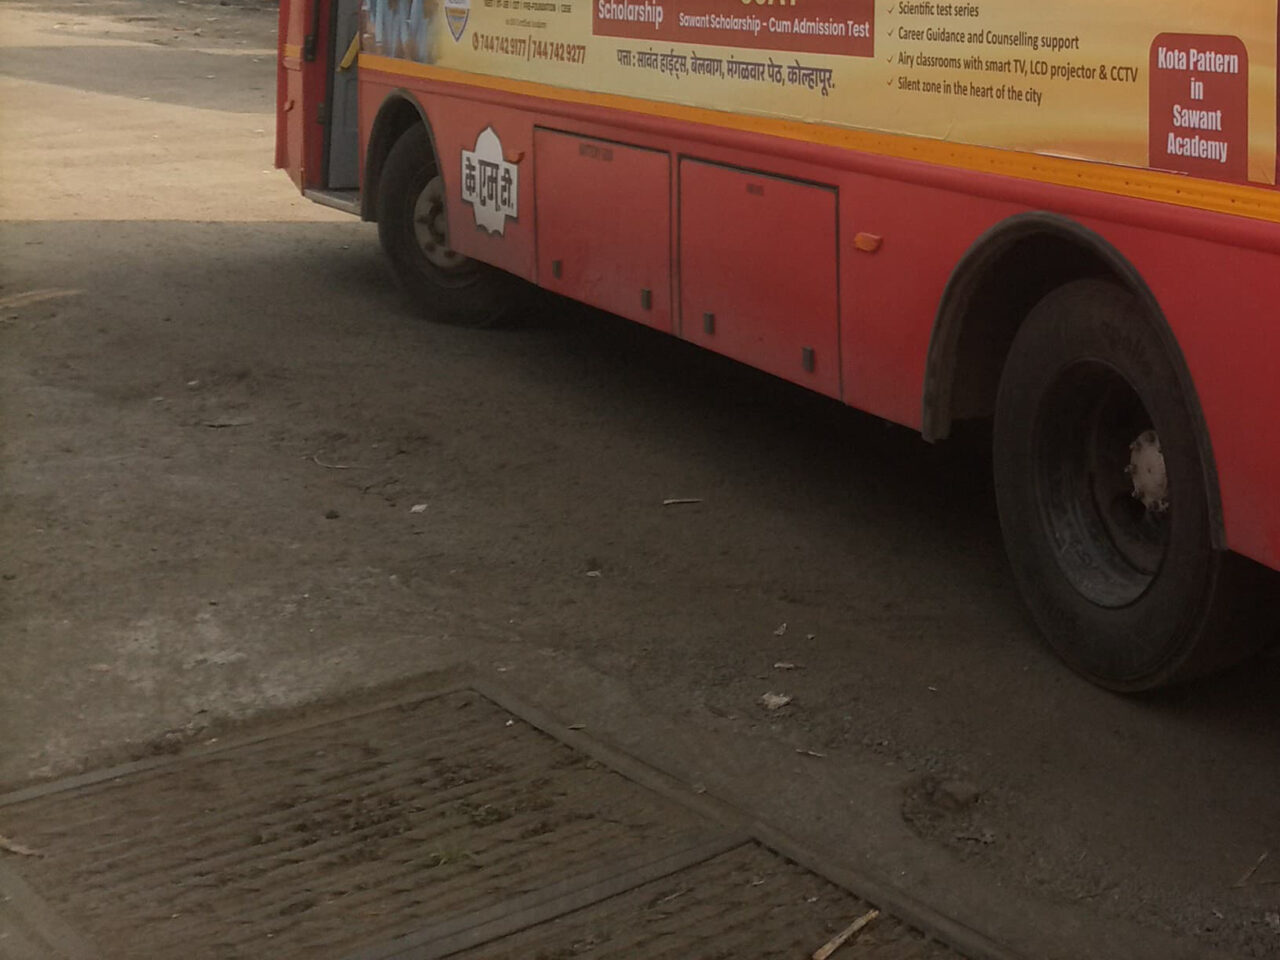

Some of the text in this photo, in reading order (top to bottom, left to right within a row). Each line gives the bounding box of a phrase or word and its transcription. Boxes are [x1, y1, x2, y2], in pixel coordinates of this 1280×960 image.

[598, 0, 664, 29] Scholarship
[898, 2, 979, 17] Scientific test series
[679, 12, 709, 28] Sawant
[710, 14, 761, 36] Scholarship
[768, 17, 792, 33] Cum
[793, 18, 845, 37] Admission
[847, 20, 870, 38] Test
[898, 26, 1079, 52] Career Guidance and Counselling support
[480, 34, 494, 53] 744
[495, 36, 509, 55] 742
[510, 38, 527, 56] 9177
[532, 40, 548, 60] 744
[549, 42, 565, 62] 742
[566, 43, 586, 64] 9277
[1157, 46, 1239, 74] Kota Pattern
[637, 47, 659, 70] सावंत
[726, 54, 765, 82] मंगळवार
[898, 51, 1138, 83] Airy classrooms with smart TV, LCD projector & CCTV
[898, 76, 1042, 106] Silent zone in the heart of the city
[1190, 77, 1204, 100] in
[1172, 104, 1222, 131] Sawant
[1167, 132, 1228, 163] Academy
